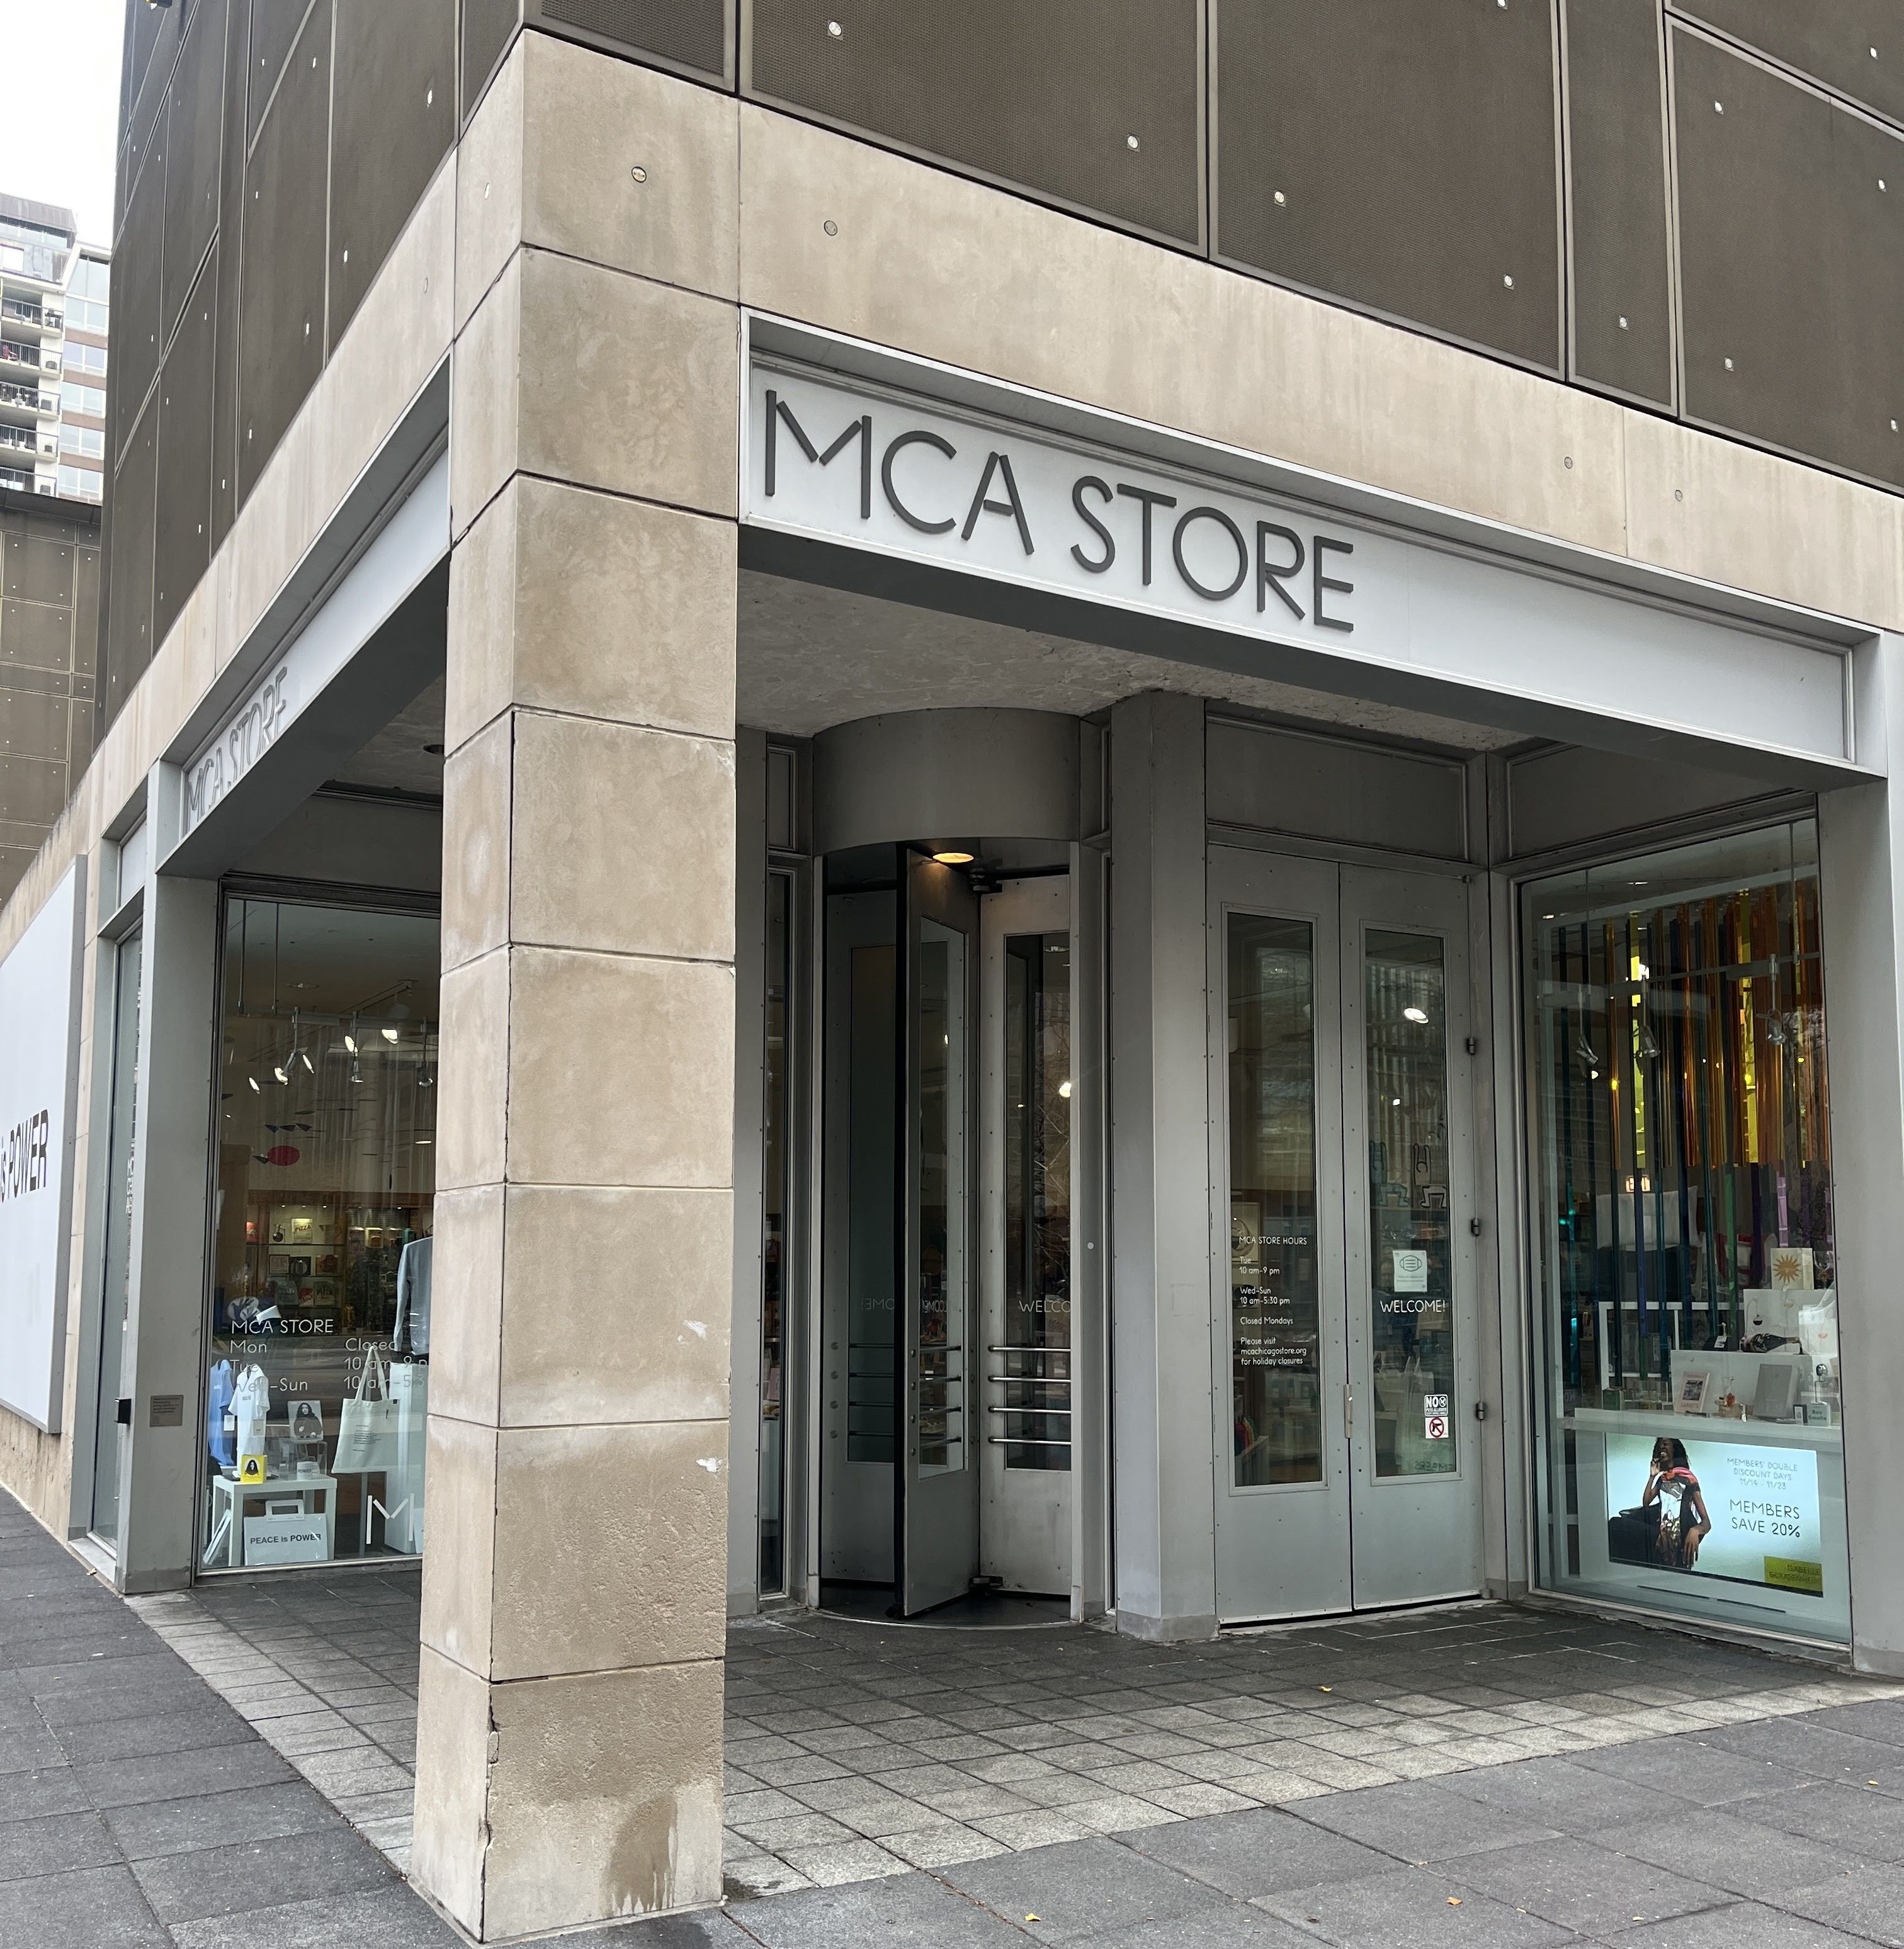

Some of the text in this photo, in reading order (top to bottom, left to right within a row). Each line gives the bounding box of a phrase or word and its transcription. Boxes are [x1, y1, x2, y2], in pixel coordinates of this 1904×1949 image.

[764, 389, 1354, 631] MCA STORE
[187, 666, 288, 832] MCA STORE
[8, 1109, 49, 1200] POWER
[1259, 1236, 1281, 1245] STORE
[1239, 1256, 1252, 1264] Tue
[1380, 1299, 1446, 1313] WELCOME!
[232, 1319, 334, 1334] MCA STORE
[1240, 1316, 1293, 1326] Closed Mondays
[230, 1340, 267, 1353] Mon
[1240, 1336, 1276, 1345] Please visit
[1240, 1347, 1306, 1356] mcachicagostore.org
[230, 1359, 259, 1374] Tue
[344, 1357, 361, 1370] 10
[1253, 1357, 1276, 1367] holiday
[1278, 1357, 1303, 1365] closures
[343, 1376, 361, 1389] 10
[1426, 1396, 1438, 1408] NO
[1767, 1461, 1798, 1472] DOUBLE
[1734, 1468, 1791, 1481] DISCOUNT DAYS
[1766, 1481, 1786, 1490] 11/23
[1730, 1499, 1799, 1519] MEMBERS
[1731, 1517, 1800, 1538] SAVE 20%
[250, 1536, 279, 1544] PEACE
[290, 1533, 322, 1542] POWER
